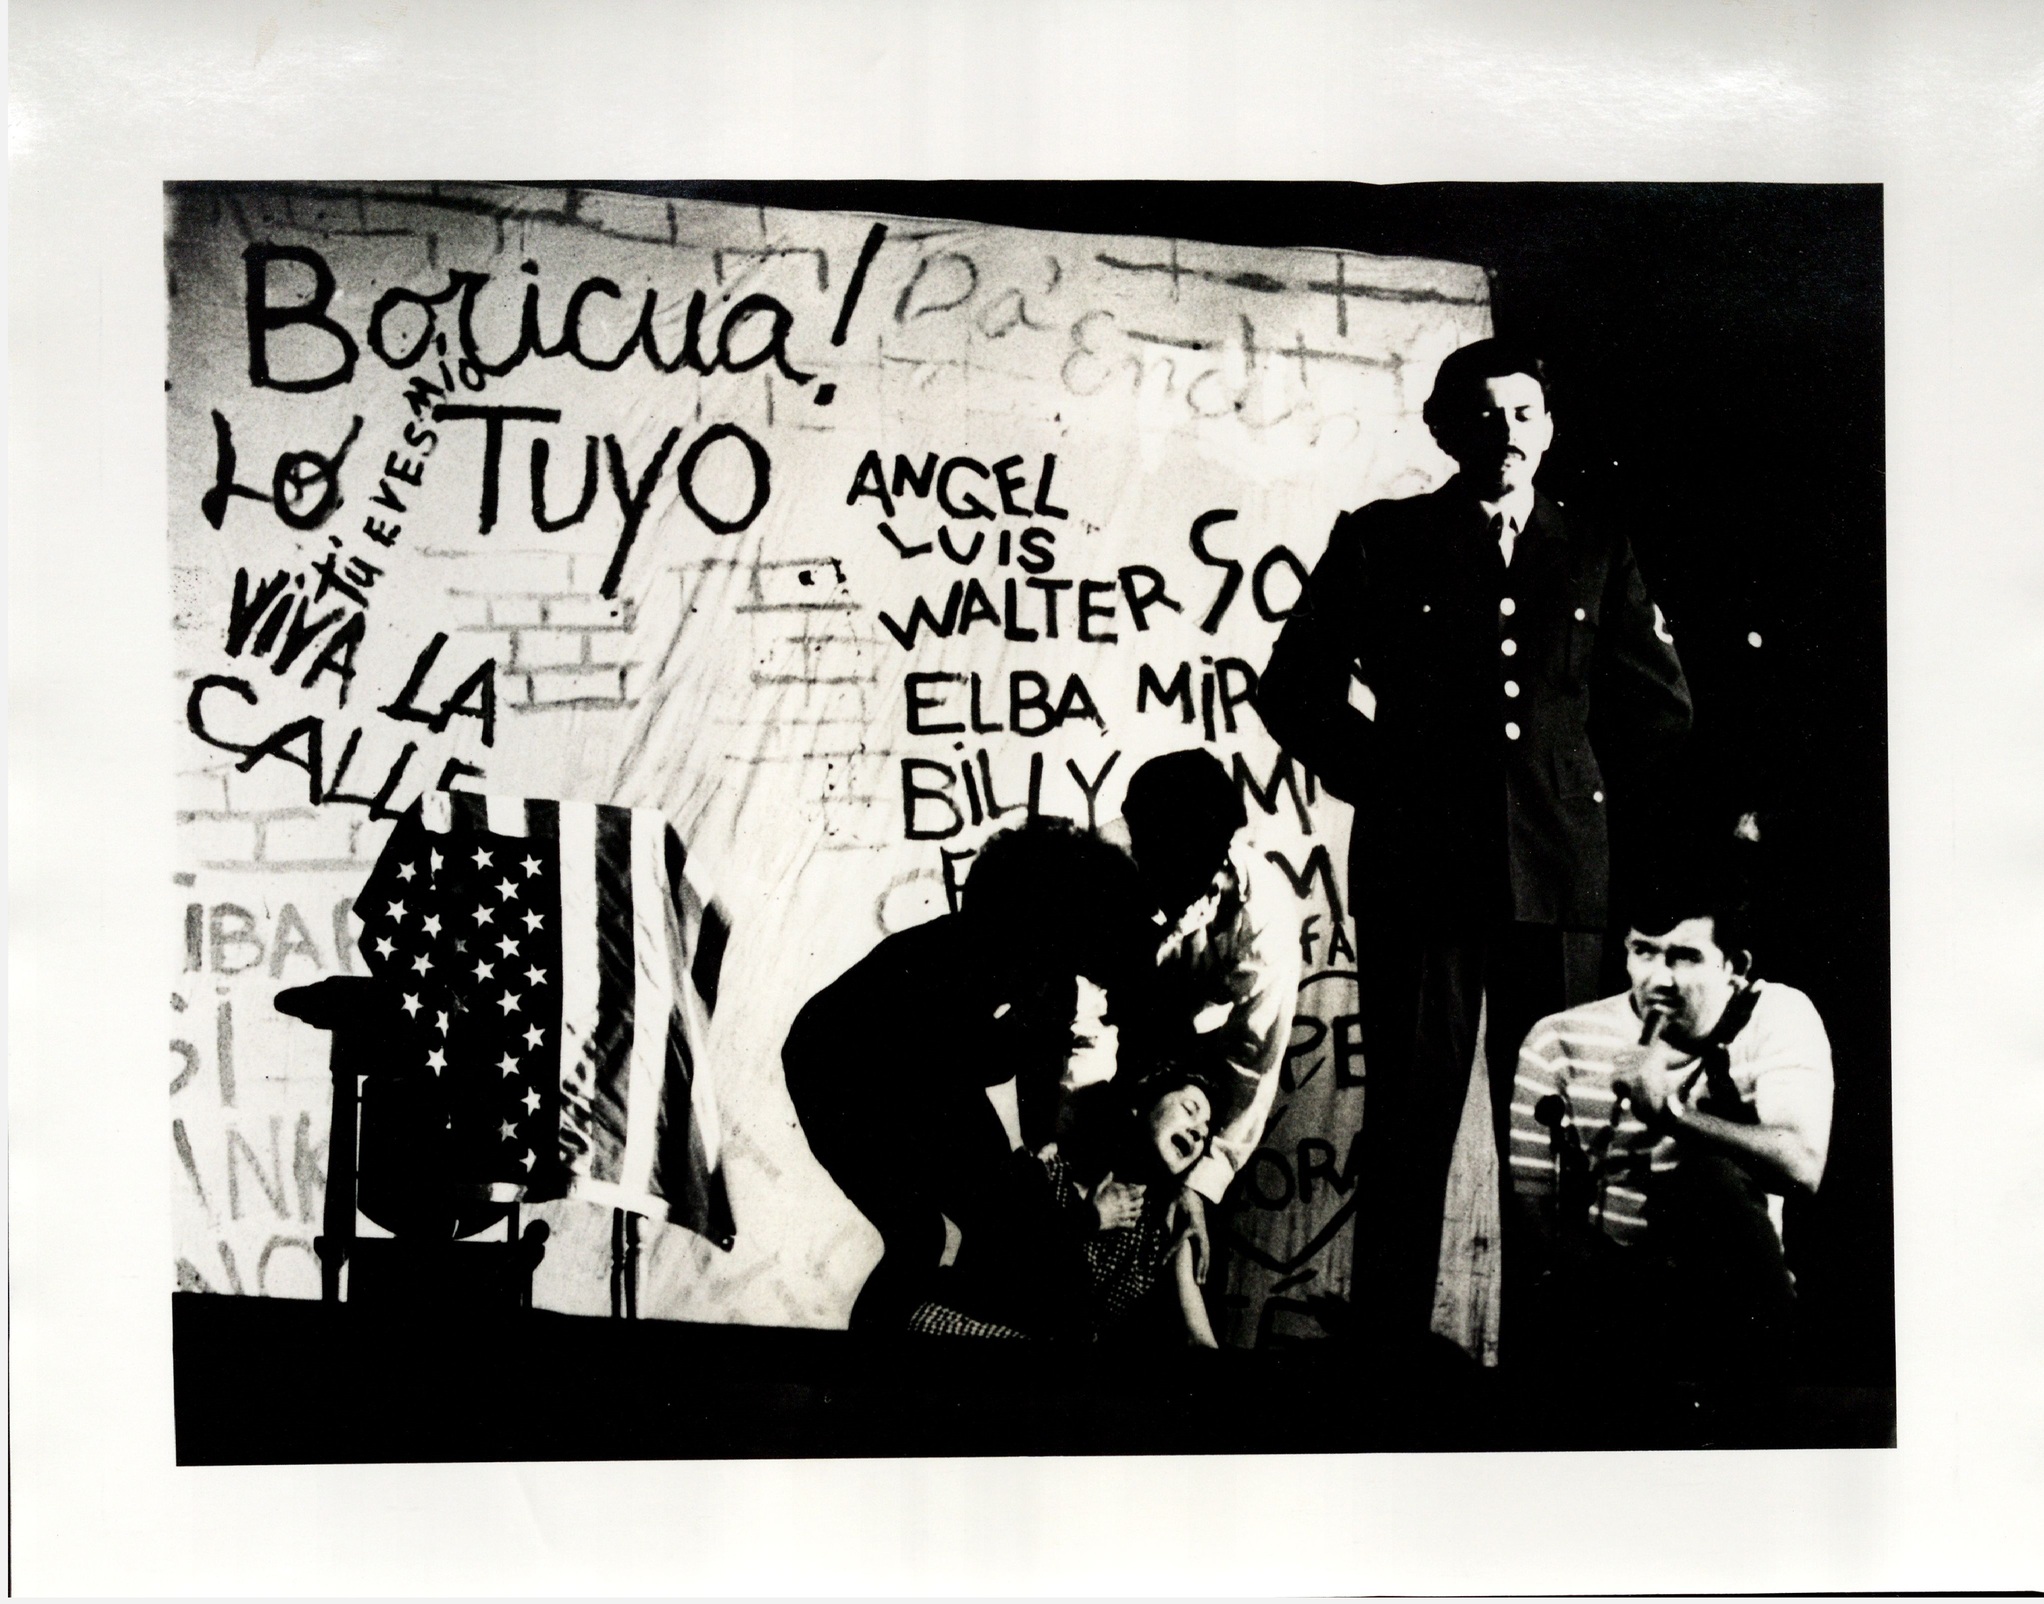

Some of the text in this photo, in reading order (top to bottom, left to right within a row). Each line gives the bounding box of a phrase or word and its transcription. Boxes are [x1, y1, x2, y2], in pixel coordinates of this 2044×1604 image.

[846, 450, 1069, 520] ANGEL
[878, 521, 1057, 575] LUIS
[878, 563, 1184, 651] WALTER
[376, 631, 497, 748] LA
[905, 670, 1107, 737] ELBA
